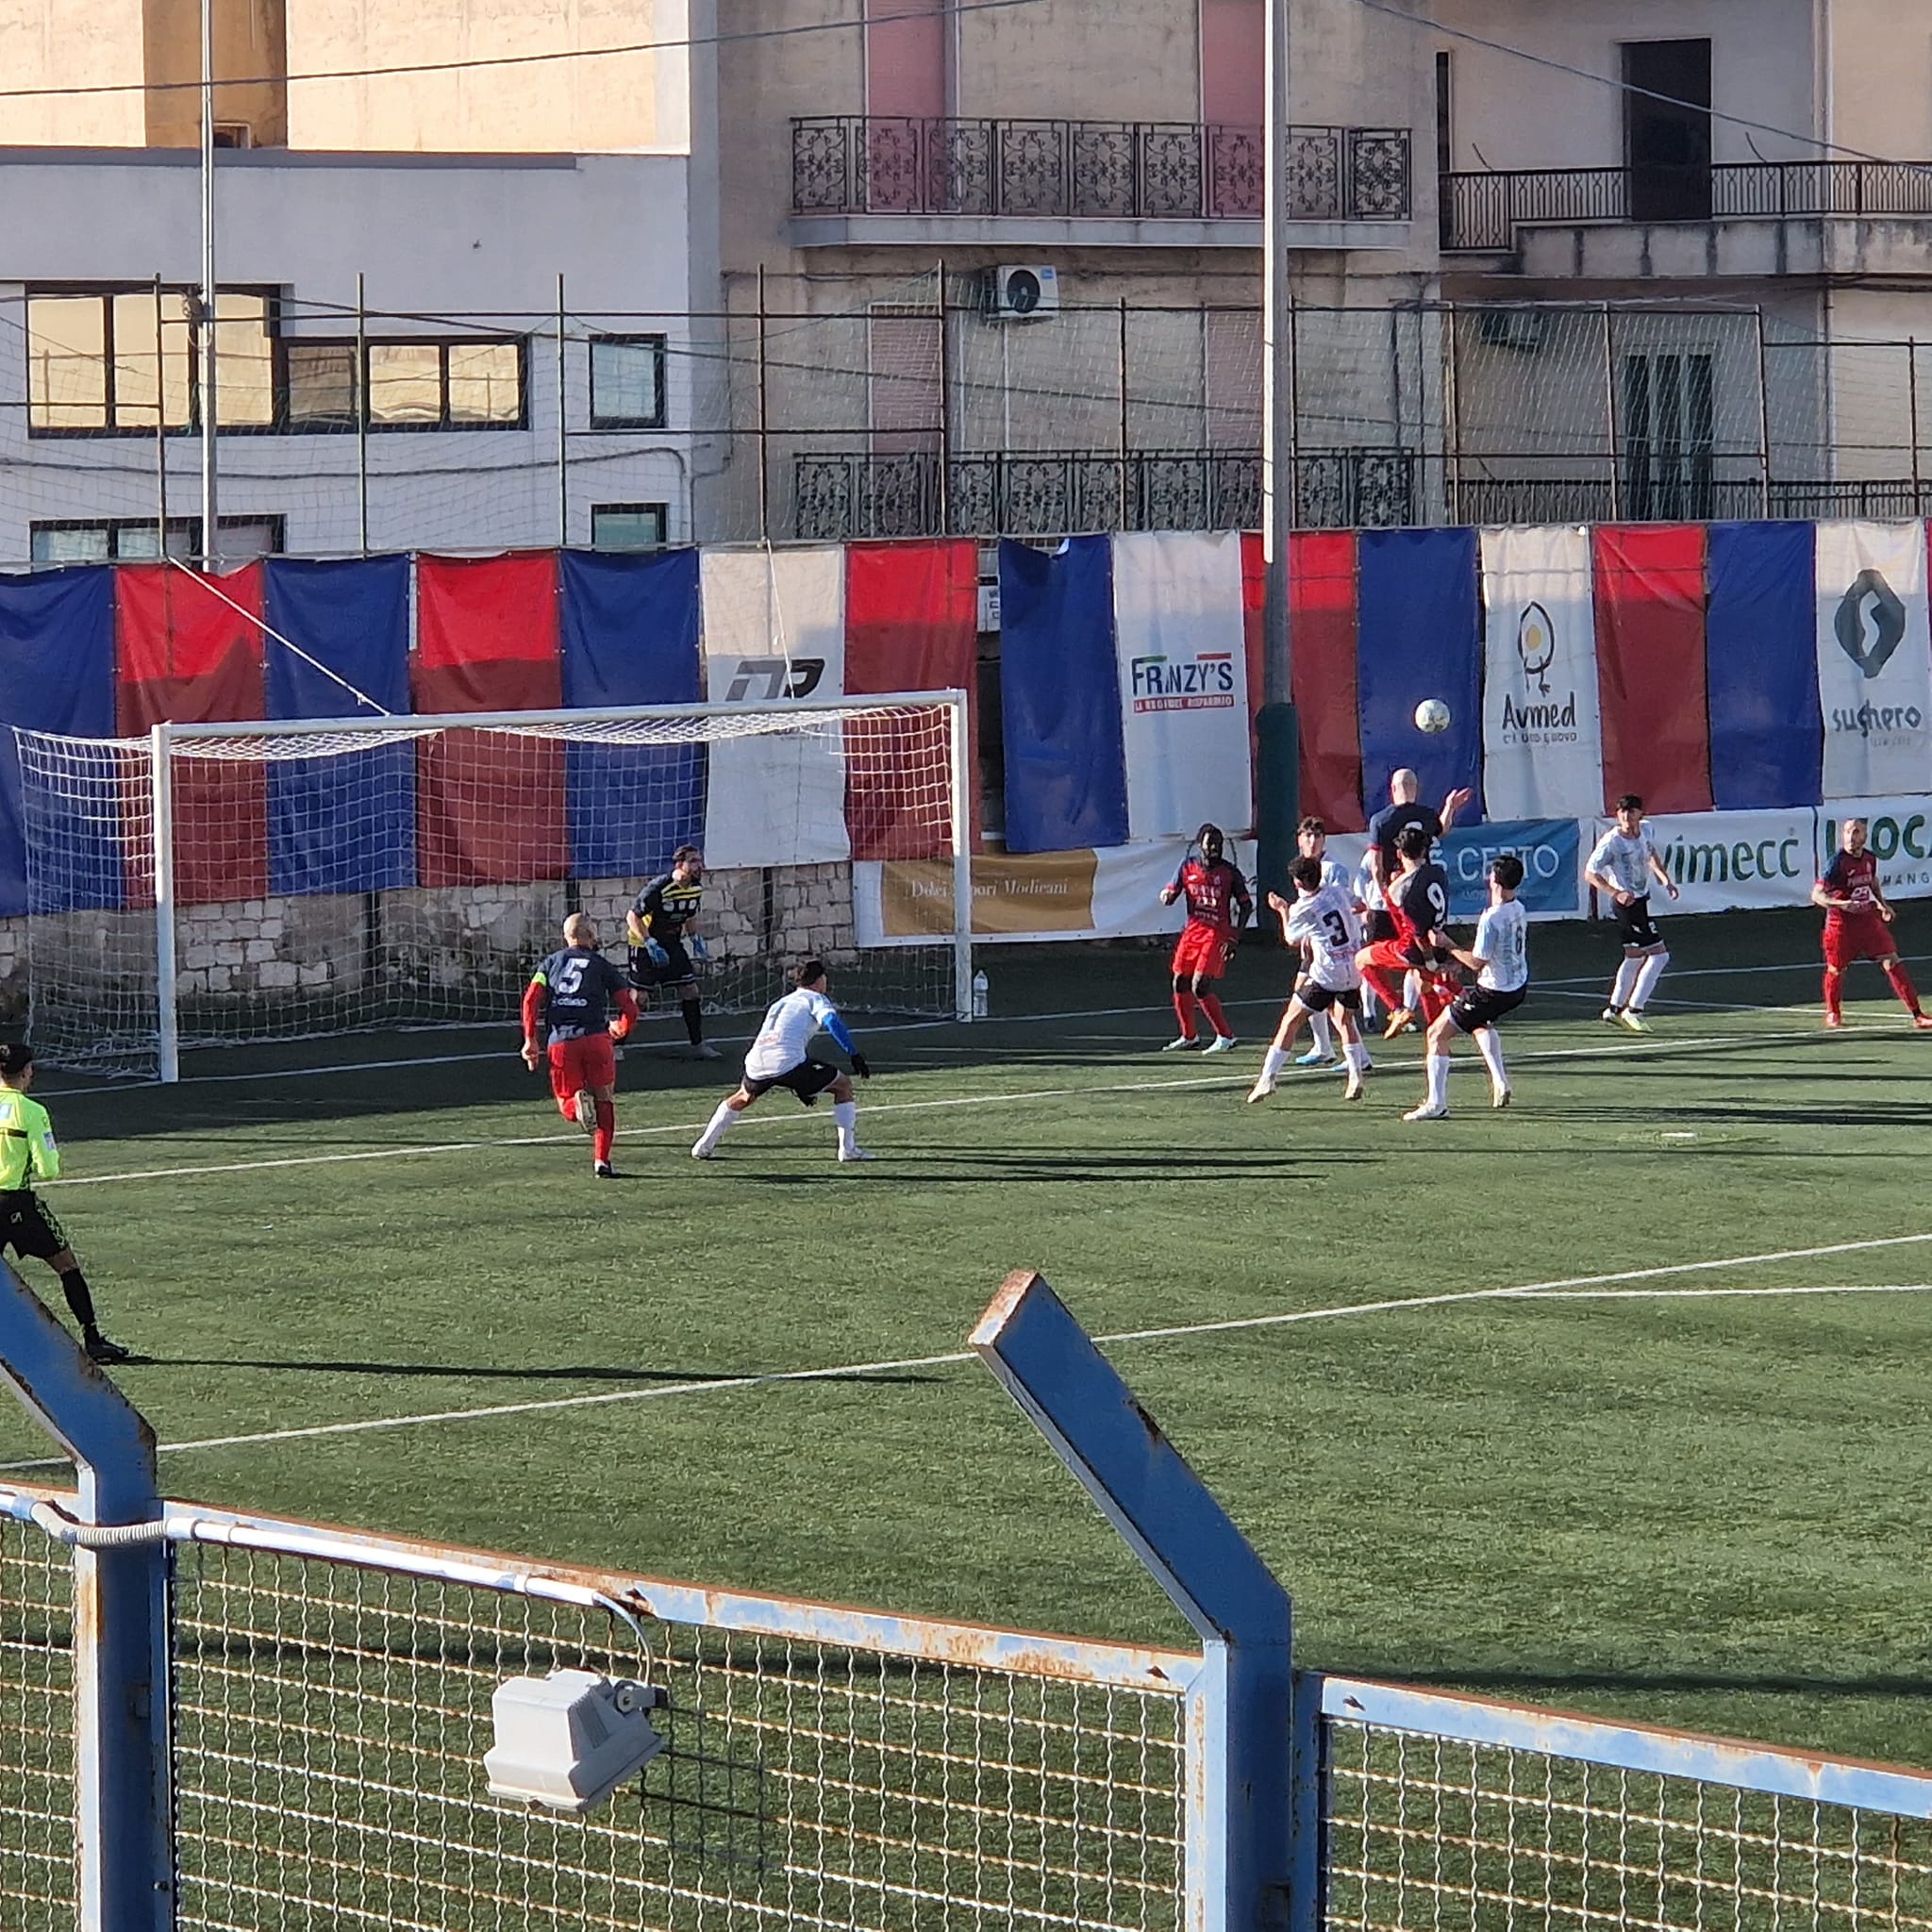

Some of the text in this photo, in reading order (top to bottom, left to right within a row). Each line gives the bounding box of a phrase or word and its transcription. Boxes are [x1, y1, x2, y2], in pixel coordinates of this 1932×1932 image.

[1502, 691, 1576, 730] Avmed
[1426, 882, 1445, 929] 9
[1323, 909, 1350, 947] 3
[558, 958, 591, 994] 5
